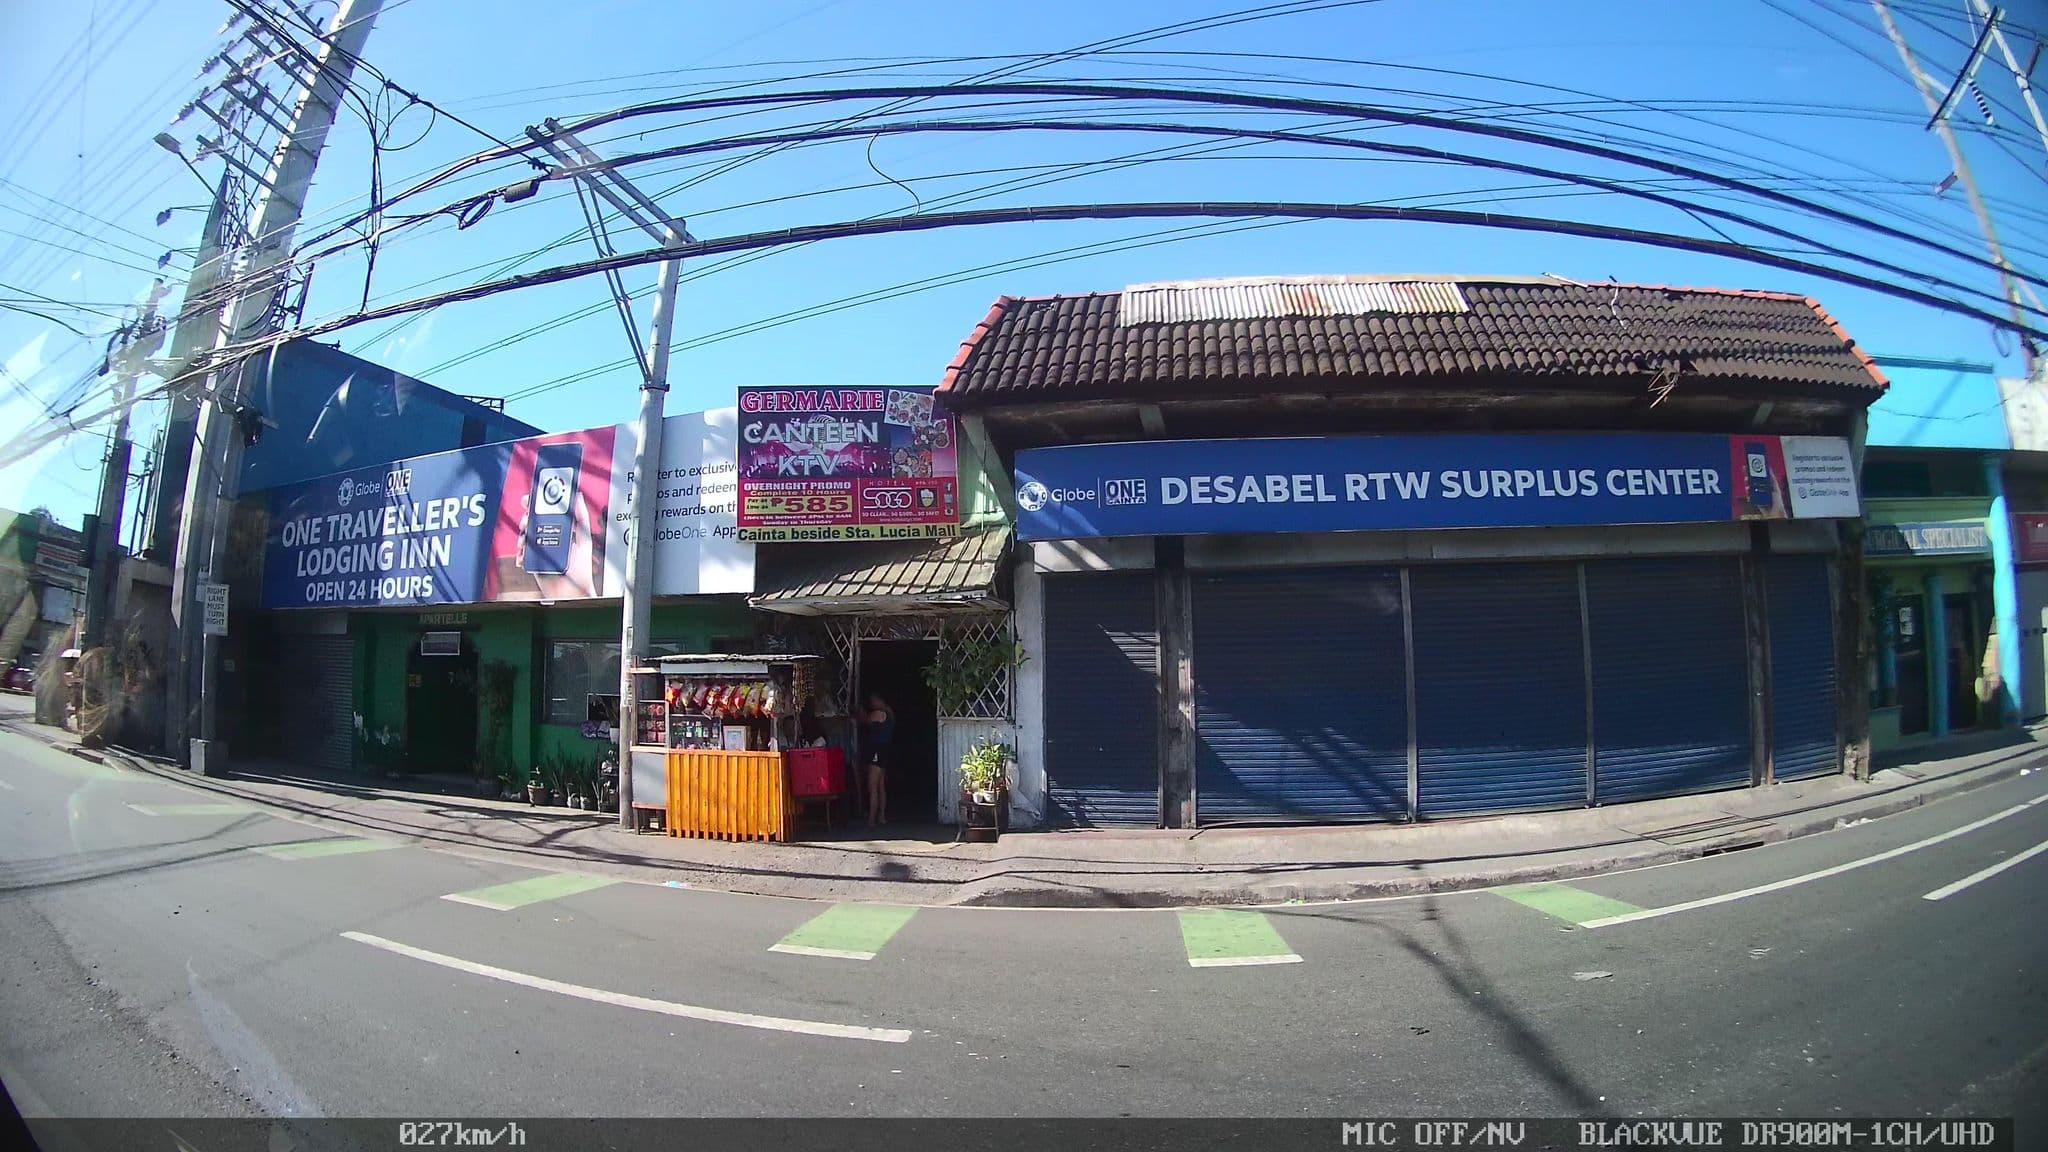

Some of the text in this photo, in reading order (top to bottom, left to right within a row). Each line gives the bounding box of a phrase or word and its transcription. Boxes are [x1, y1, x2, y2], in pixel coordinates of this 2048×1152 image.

[741, 390, 885, 413] GERMARIE
[744, 422, 879, 444] CANTEEN
[675, 468, 686, 478] to
[778, 455, 842, 476] KTV
[355, 481, 381, 496] Globe
[387, 469, 411, 490] ONE
[744, 481, 852, 491] OVERNIGHT PROMO
[1106, 480, 1145, 498] ONE
[1161, 468, 1722, 505] DESABEL RTW SURPLUS CENTER
[672, 485, 693, 497] and
[863, 487, 912, 508] SOGO
[1051, 487, 1095, 502] Globe
[661, 504, 706, 518] rewards
[709, 504, 724, 513] on
[281, 494, 487, 548] ONE TRAVELLER'S
[655, 525, 707, 541] lobeOne
[738, 524, 956, 541] Cainta beside Sta. Lucia Mall
[297, 534, 451, 577] LODGING INN
[306, 575, 433, 601] OPEN 24 HOURS
